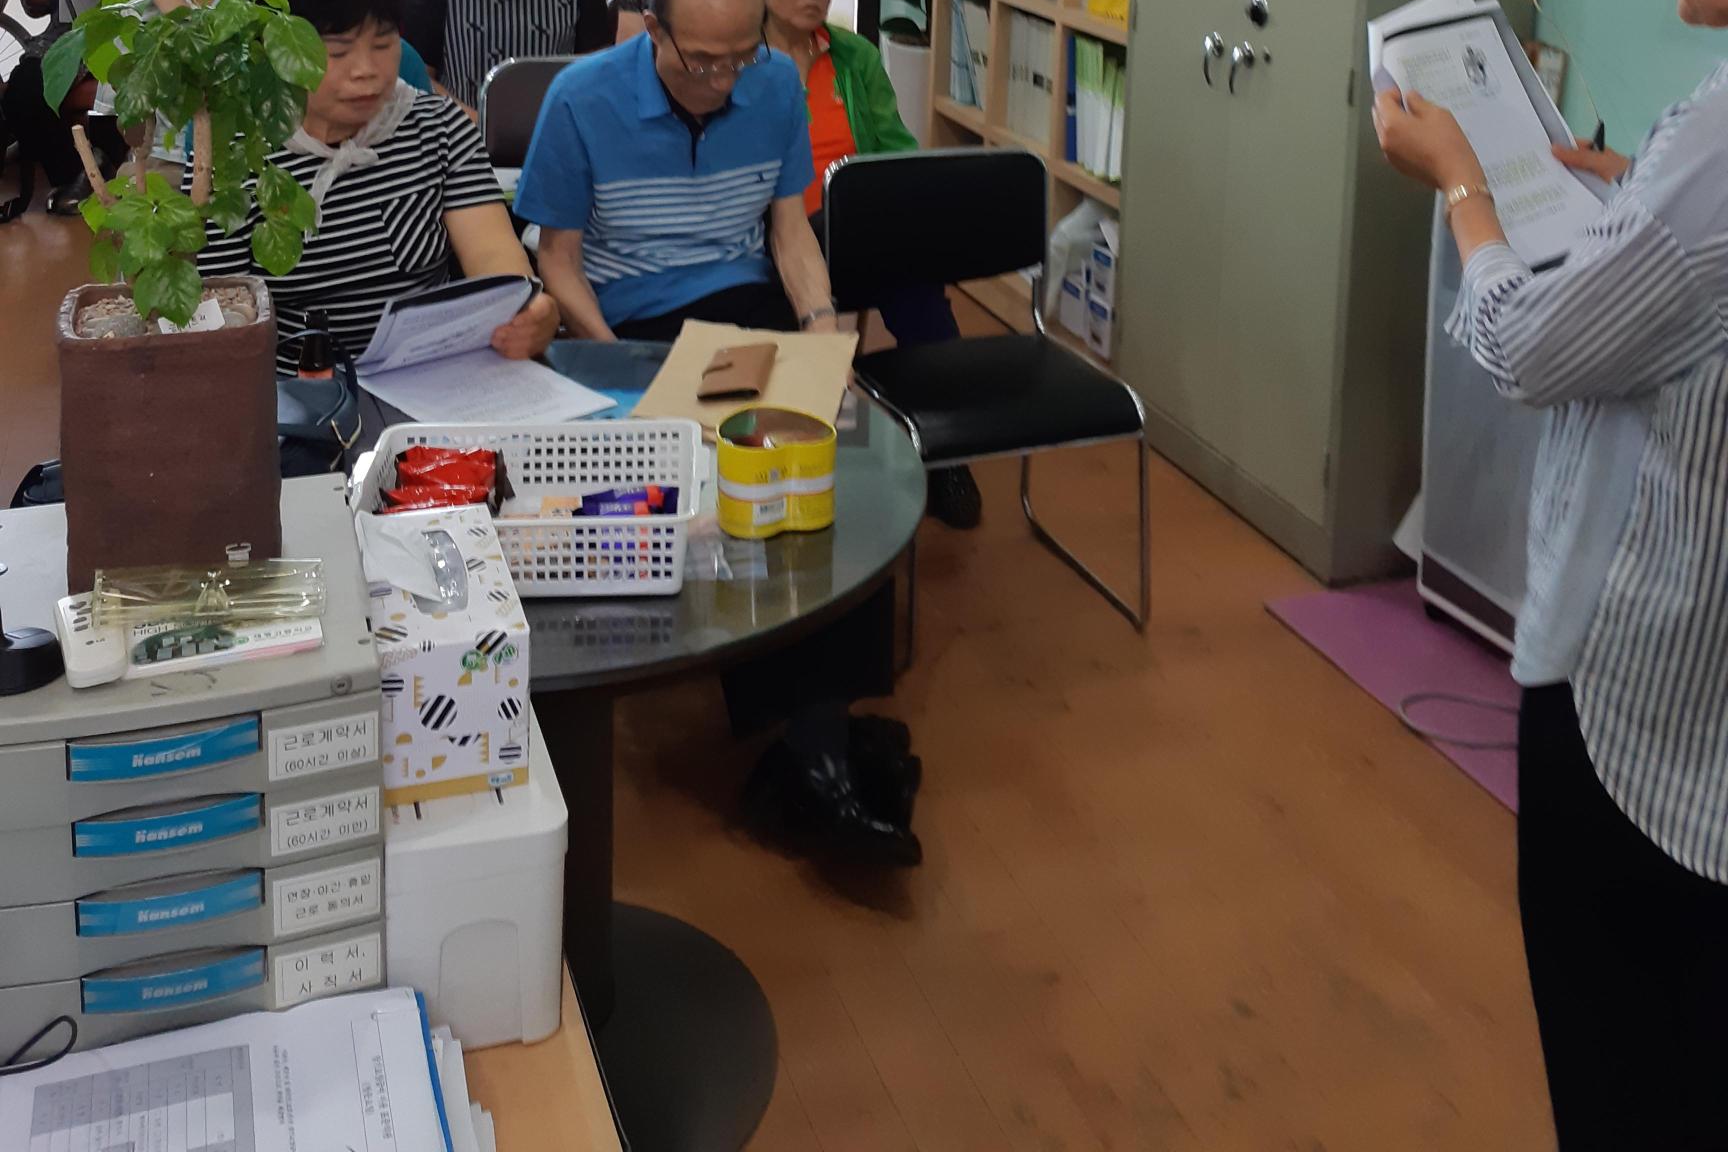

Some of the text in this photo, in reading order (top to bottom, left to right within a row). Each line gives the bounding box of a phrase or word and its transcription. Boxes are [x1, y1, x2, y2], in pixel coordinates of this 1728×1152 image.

[284, 719, 367, 751] 근로계약서
[285, 752, 330, 773] (60시간
[286, 795, 368, 827] 근로계약서
[287, 827, 331, 849] (60시간
